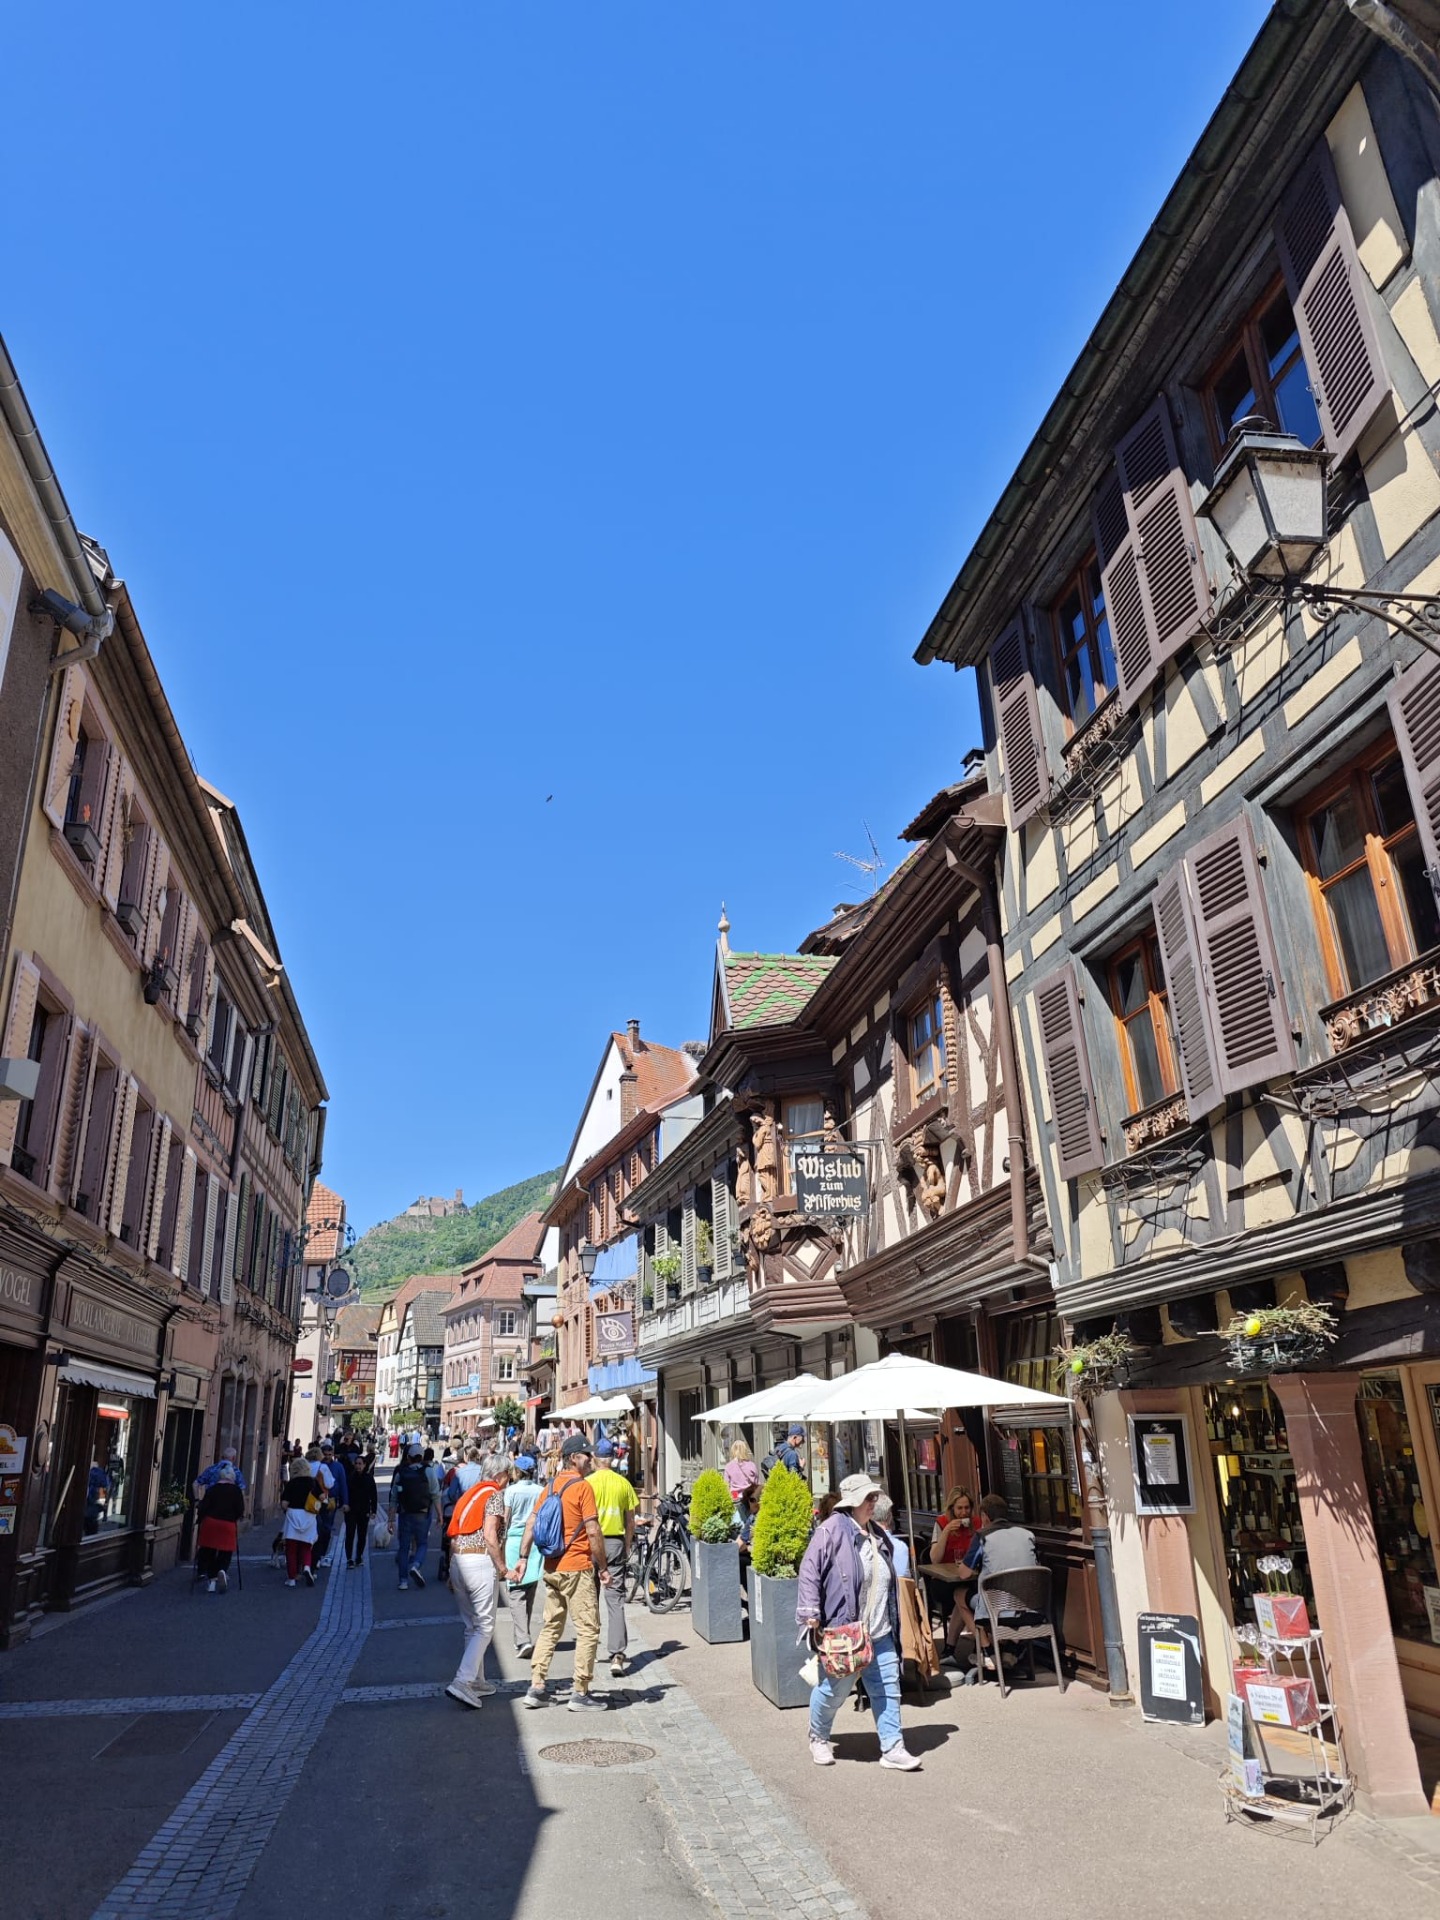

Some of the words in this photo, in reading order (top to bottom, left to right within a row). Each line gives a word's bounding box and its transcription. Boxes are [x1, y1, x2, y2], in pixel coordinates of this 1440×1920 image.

[797, 1156, 861, 1181] Wistub
[819, 1181, 844, 1191] zum
[803, 1192, 862, 1213] Pfifferhüs
[0, 1267, 31, 1306] VOGEL
[1357, 1381, 1383, 1399] INS
